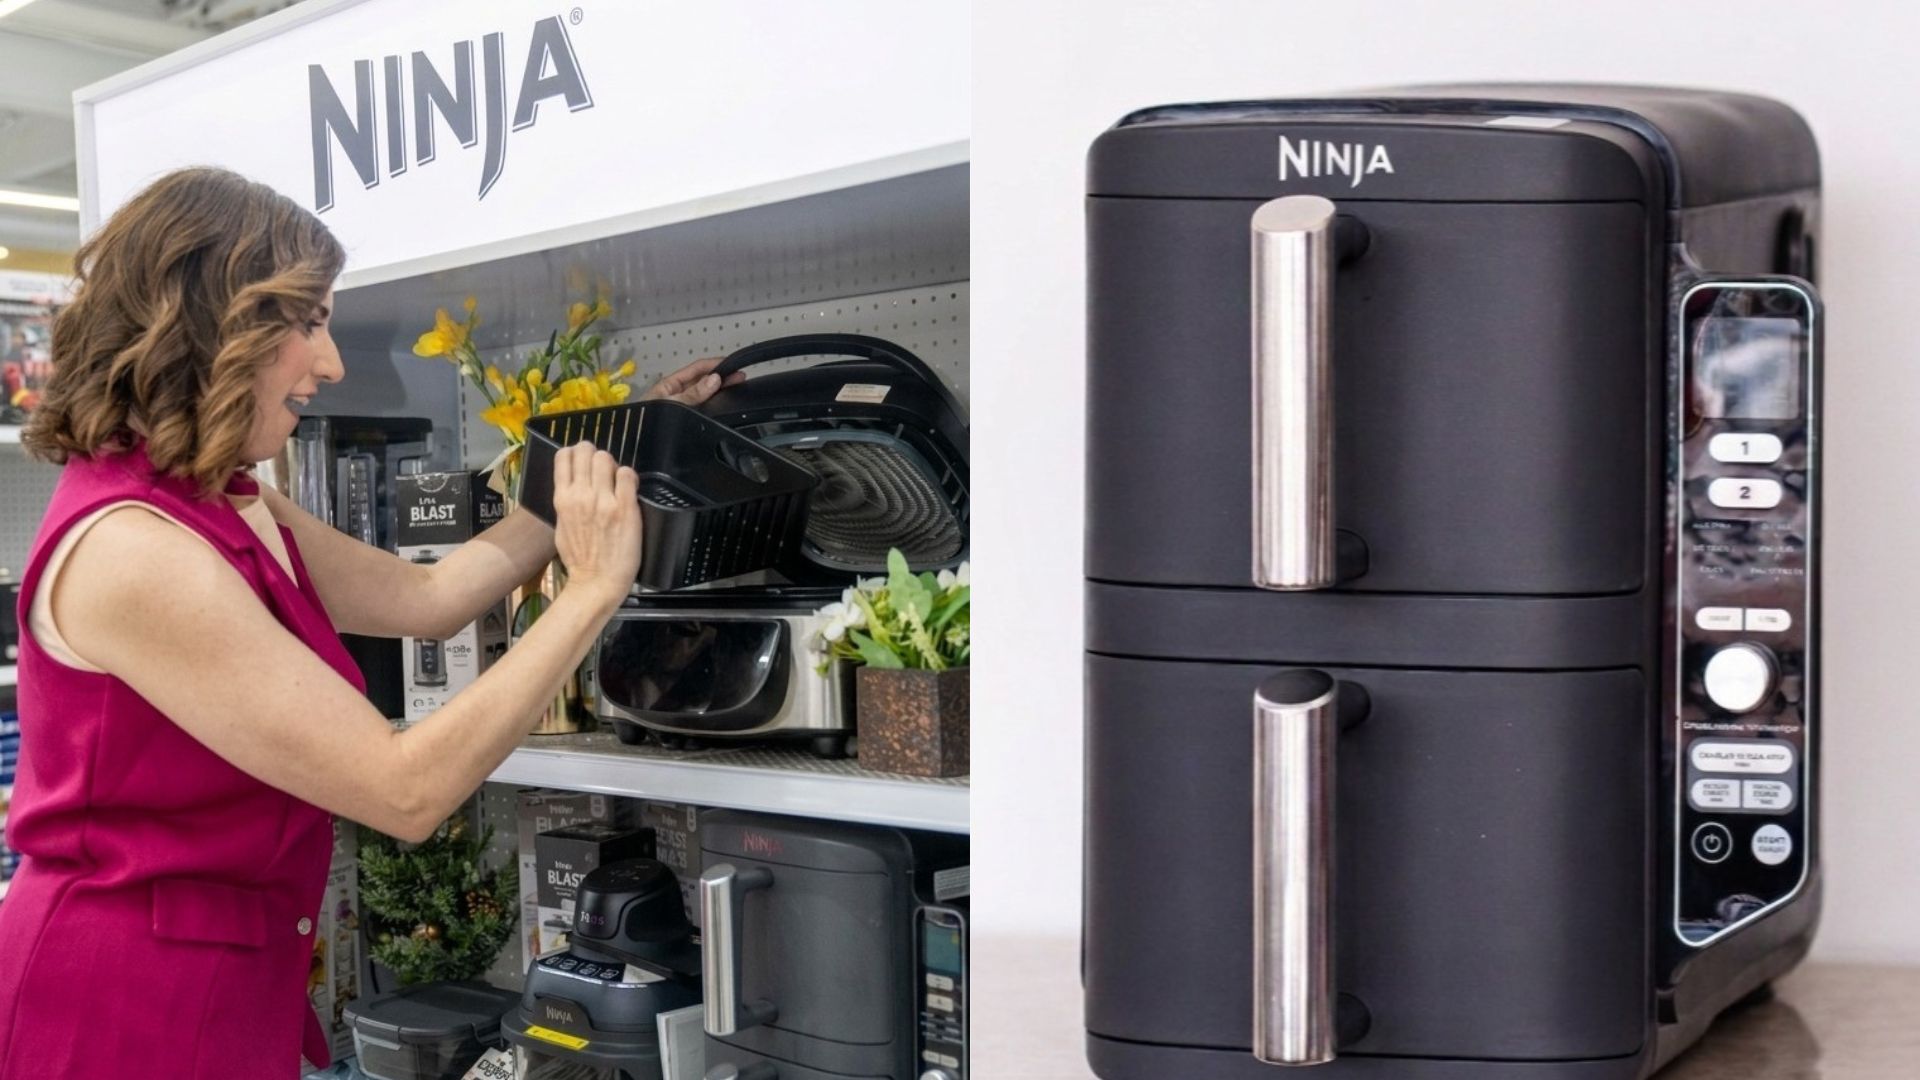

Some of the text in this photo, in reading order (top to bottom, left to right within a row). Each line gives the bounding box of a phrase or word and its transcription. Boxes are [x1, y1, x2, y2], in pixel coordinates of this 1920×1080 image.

[308, 14, 594, 215] NINJA
[1279, 135, 1395, 189] NINJA
[1740, 441, 1750, 456] 1
[1739, 486, 1751, 499] 2
[410, 504, 456, 521] BLAST
